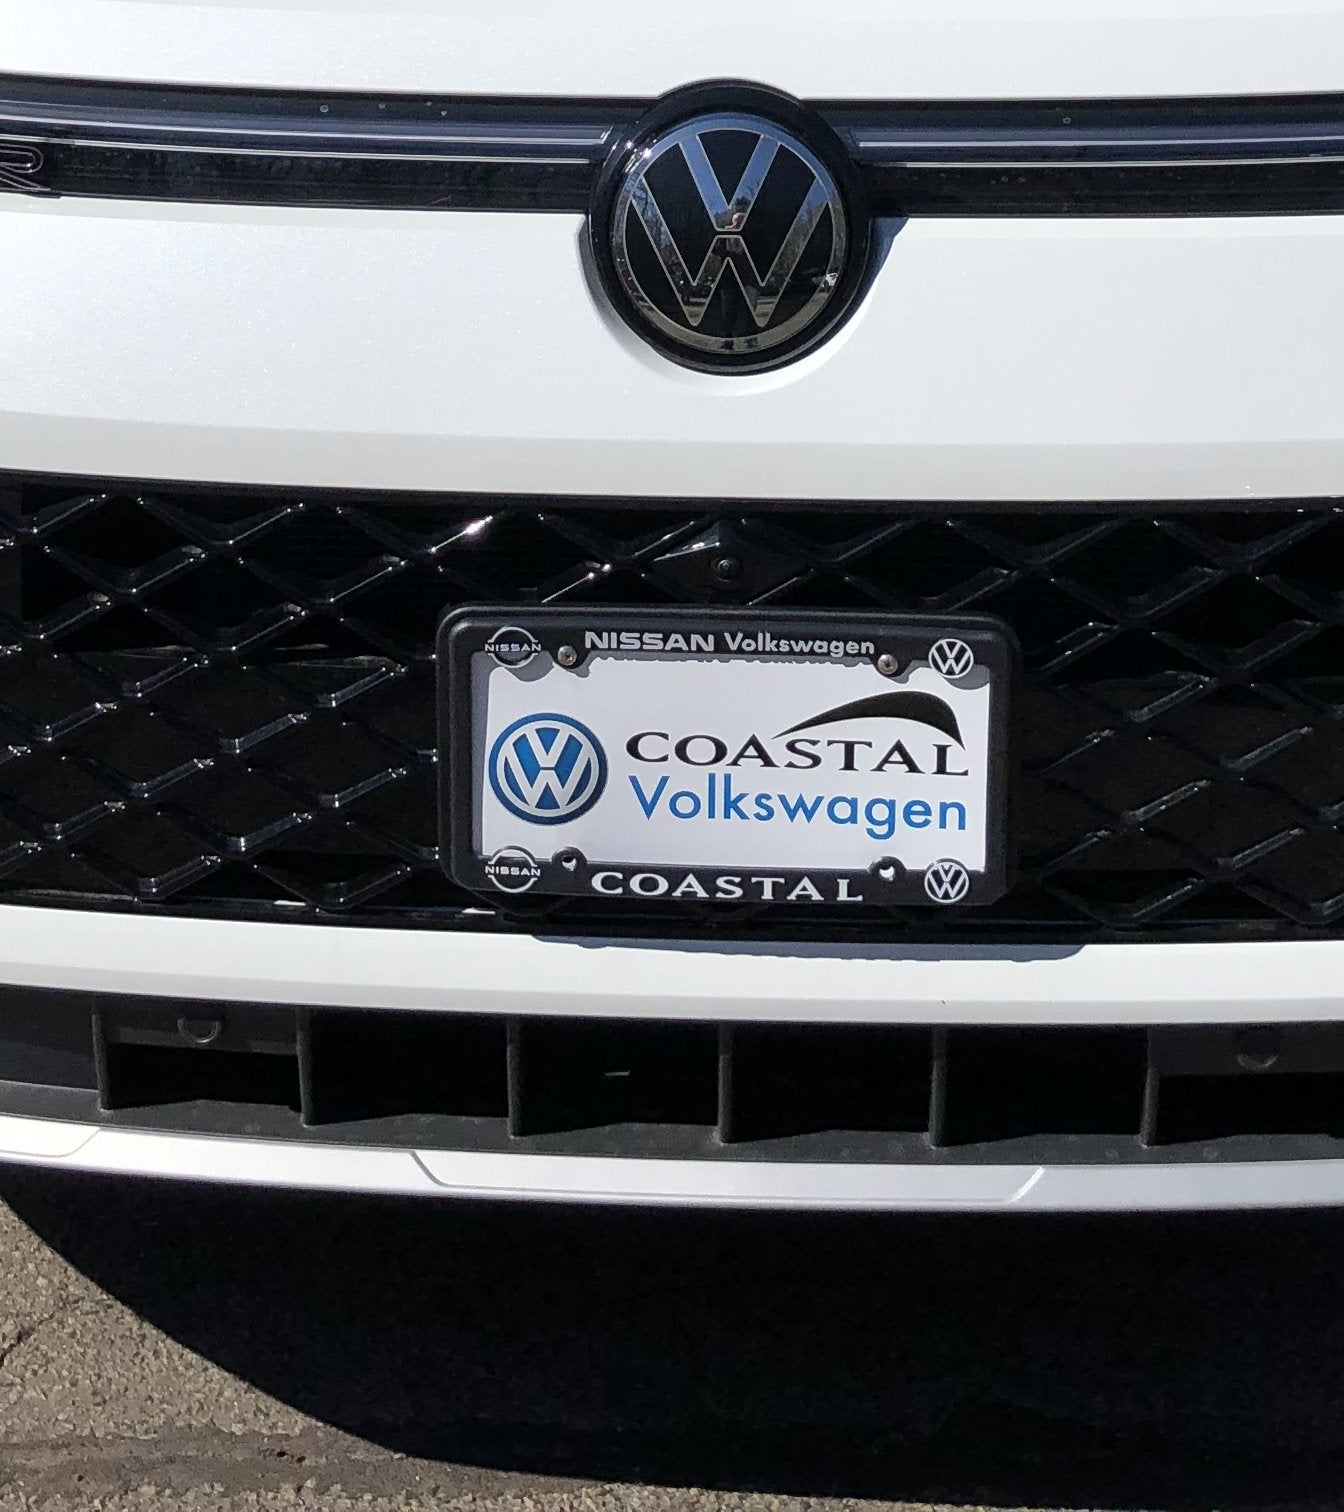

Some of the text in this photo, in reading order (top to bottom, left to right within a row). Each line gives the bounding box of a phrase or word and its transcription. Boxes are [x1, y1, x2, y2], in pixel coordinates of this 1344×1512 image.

[484, 642, 542, 652] NISSAN
[584, 630, 875, 658] NISSAN Volkswagen
[625, 730, 970, 777] COASTAL
[628, 772, 968, 841] Volkswagen
[484, 865, 541, 877] NISSAN
[591, 870, 864, 902] COASTAL
